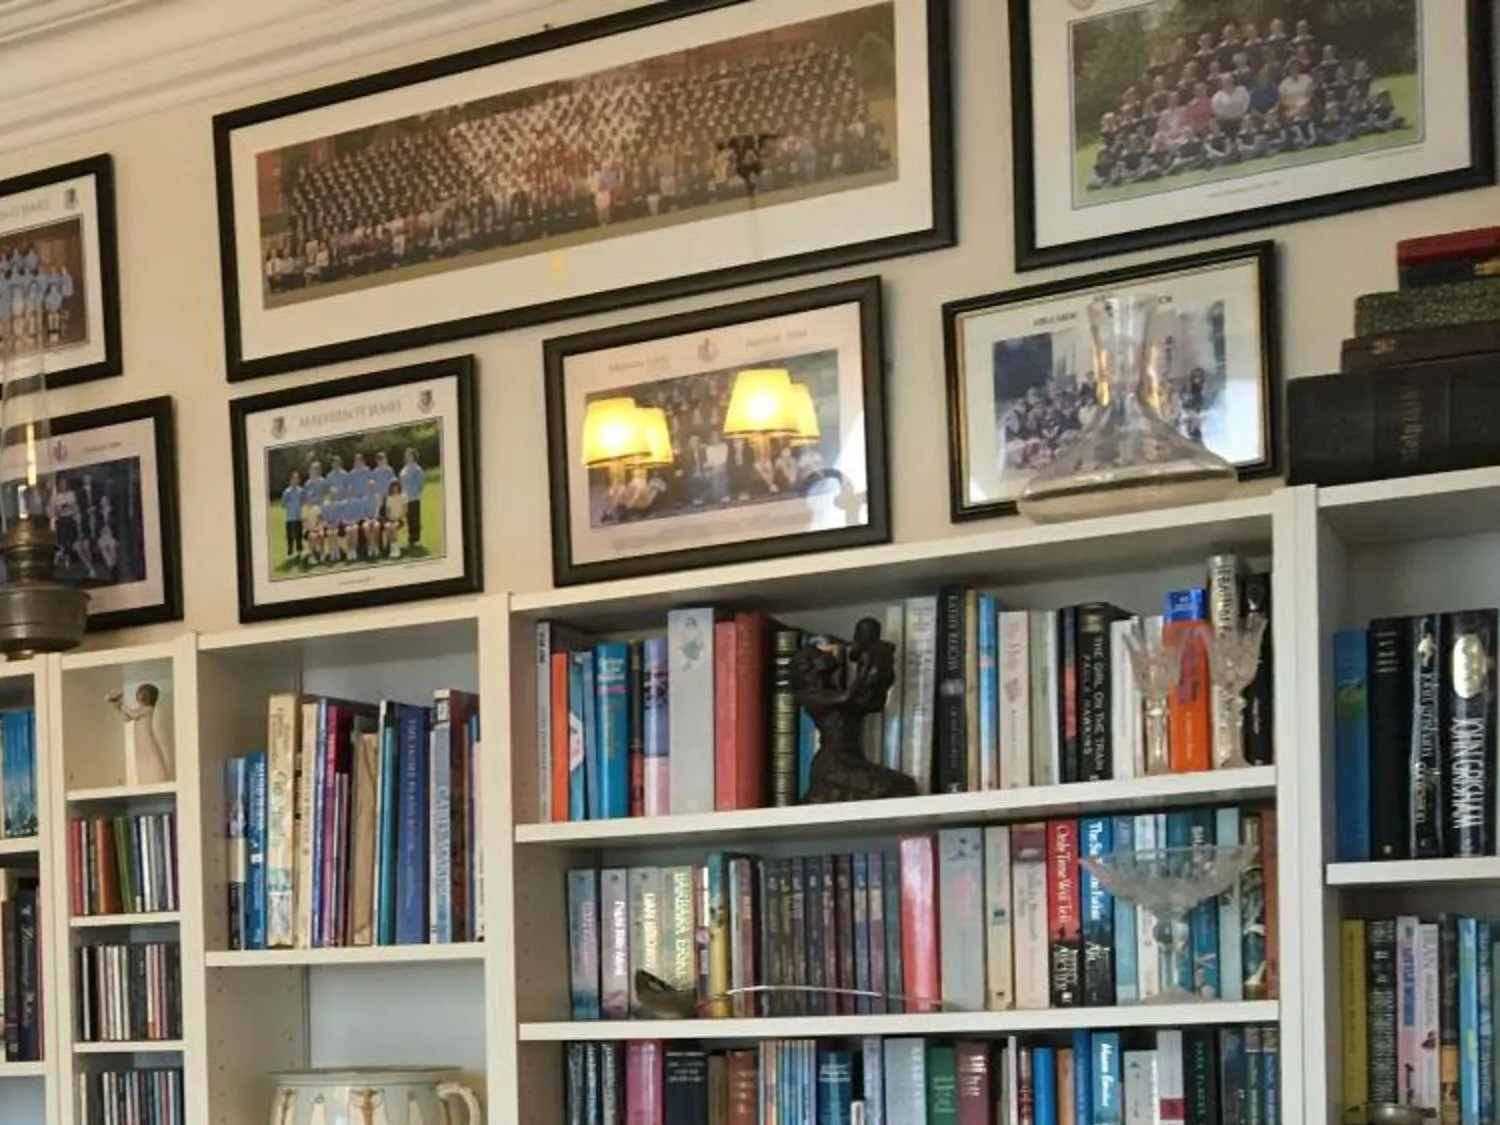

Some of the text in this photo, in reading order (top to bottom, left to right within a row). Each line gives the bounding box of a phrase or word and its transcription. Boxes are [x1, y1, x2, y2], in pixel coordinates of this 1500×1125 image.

[1093, 636, 1105, 770] THE GIRL ON THE TRAIN
[1452, 717, 1484, 829] JOHN GRISHAM
[1056, 853, 1071, 879] Time
